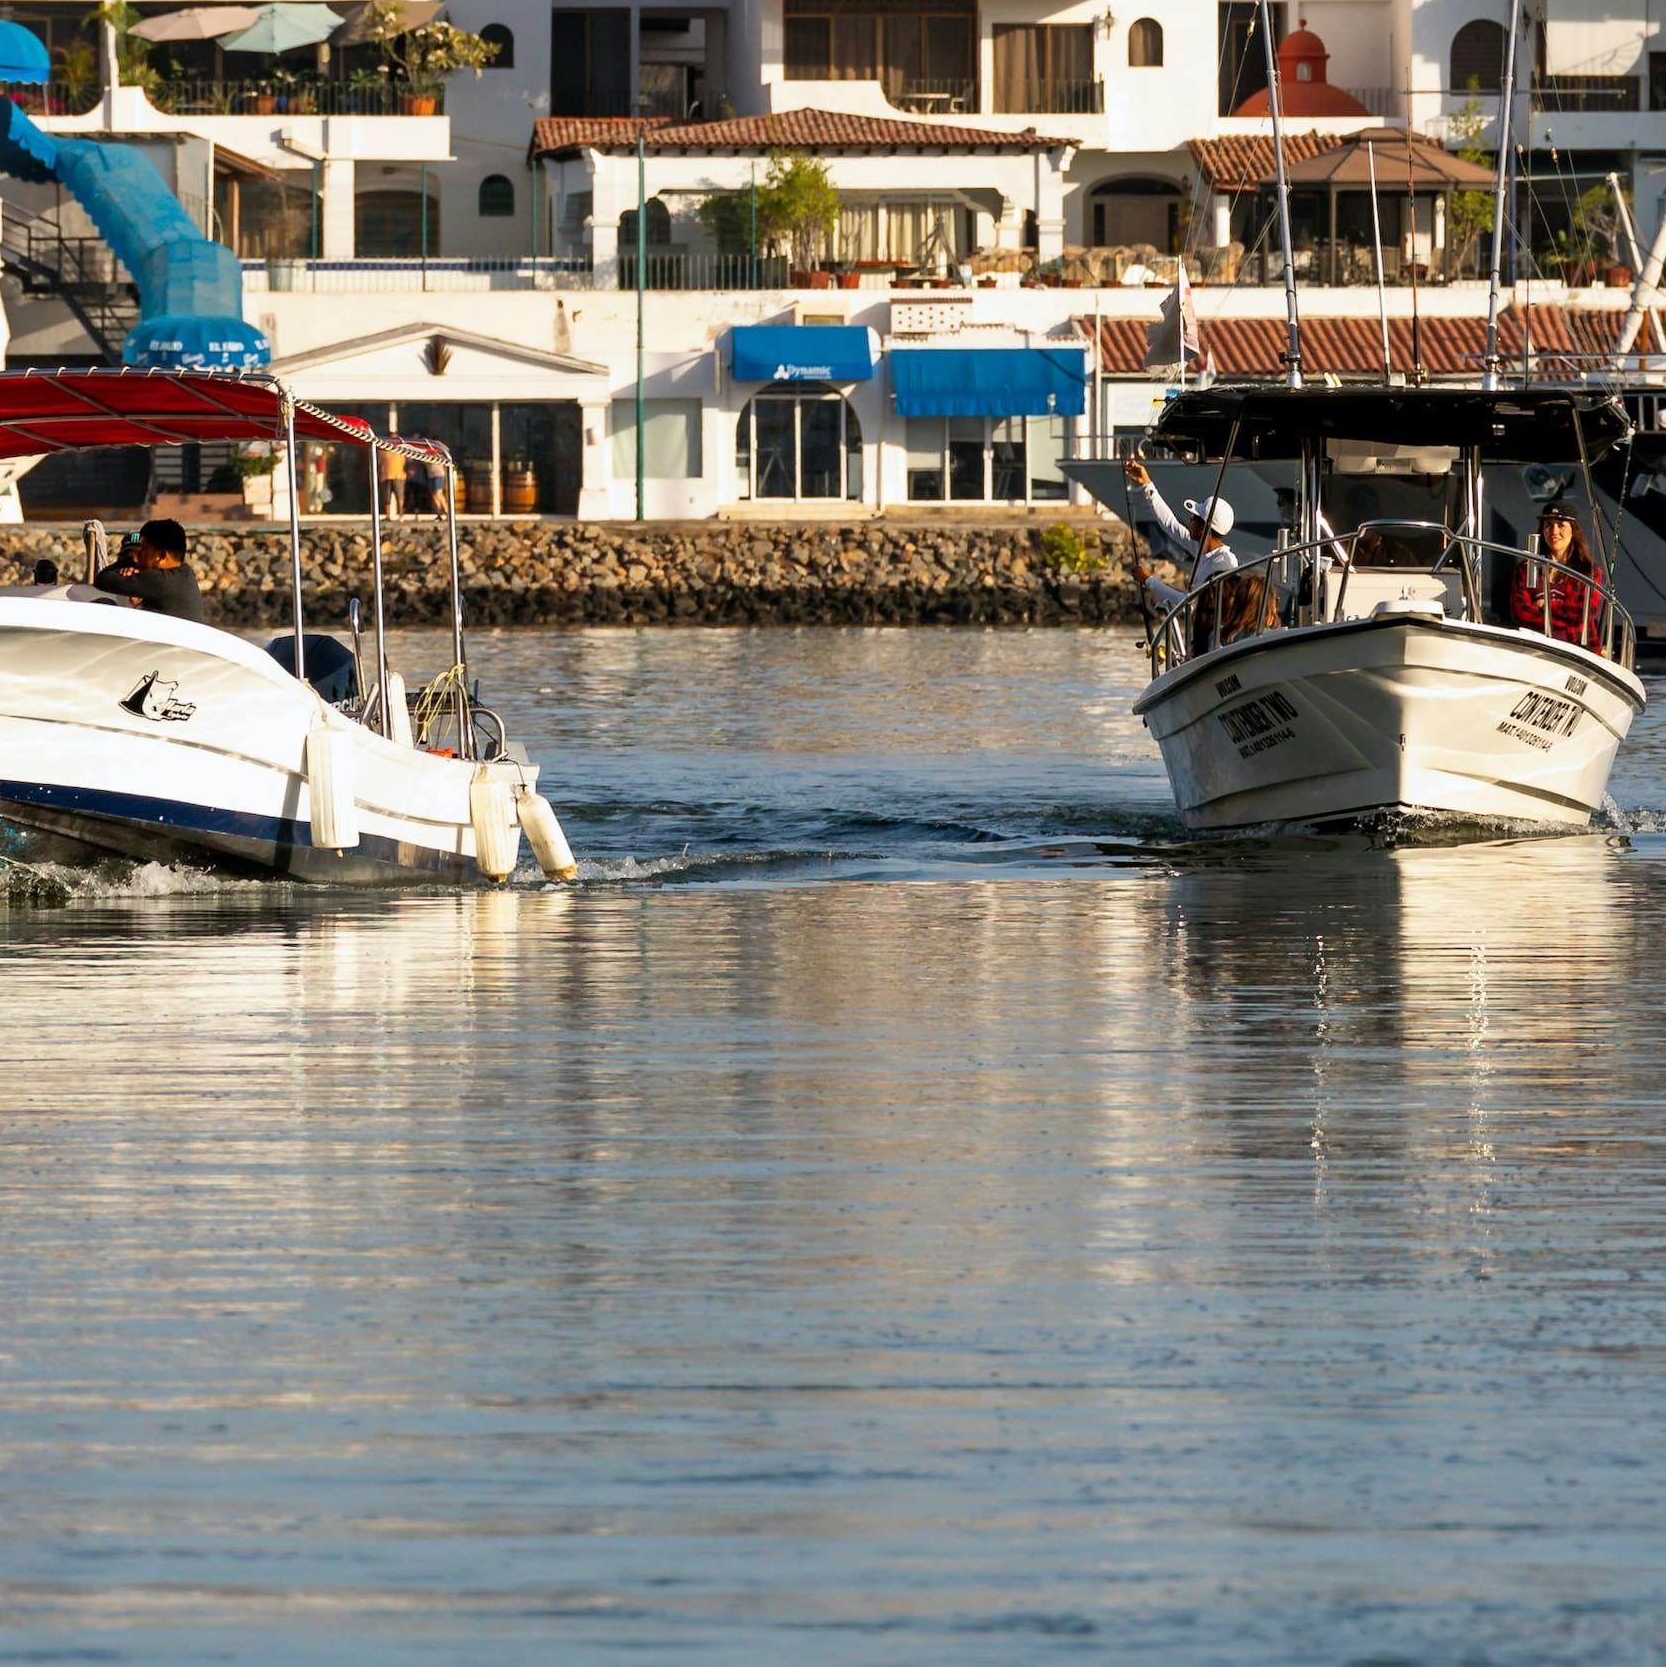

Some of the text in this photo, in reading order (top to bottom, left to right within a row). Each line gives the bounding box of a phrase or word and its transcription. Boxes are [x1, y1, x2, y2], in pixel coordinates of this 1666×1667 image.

[787, 364, 832, 378] Dynamic
[1217, 690, 1300, 745] CONTENDER TWO
[1509, 690, 1571, 734] CONTENDER
